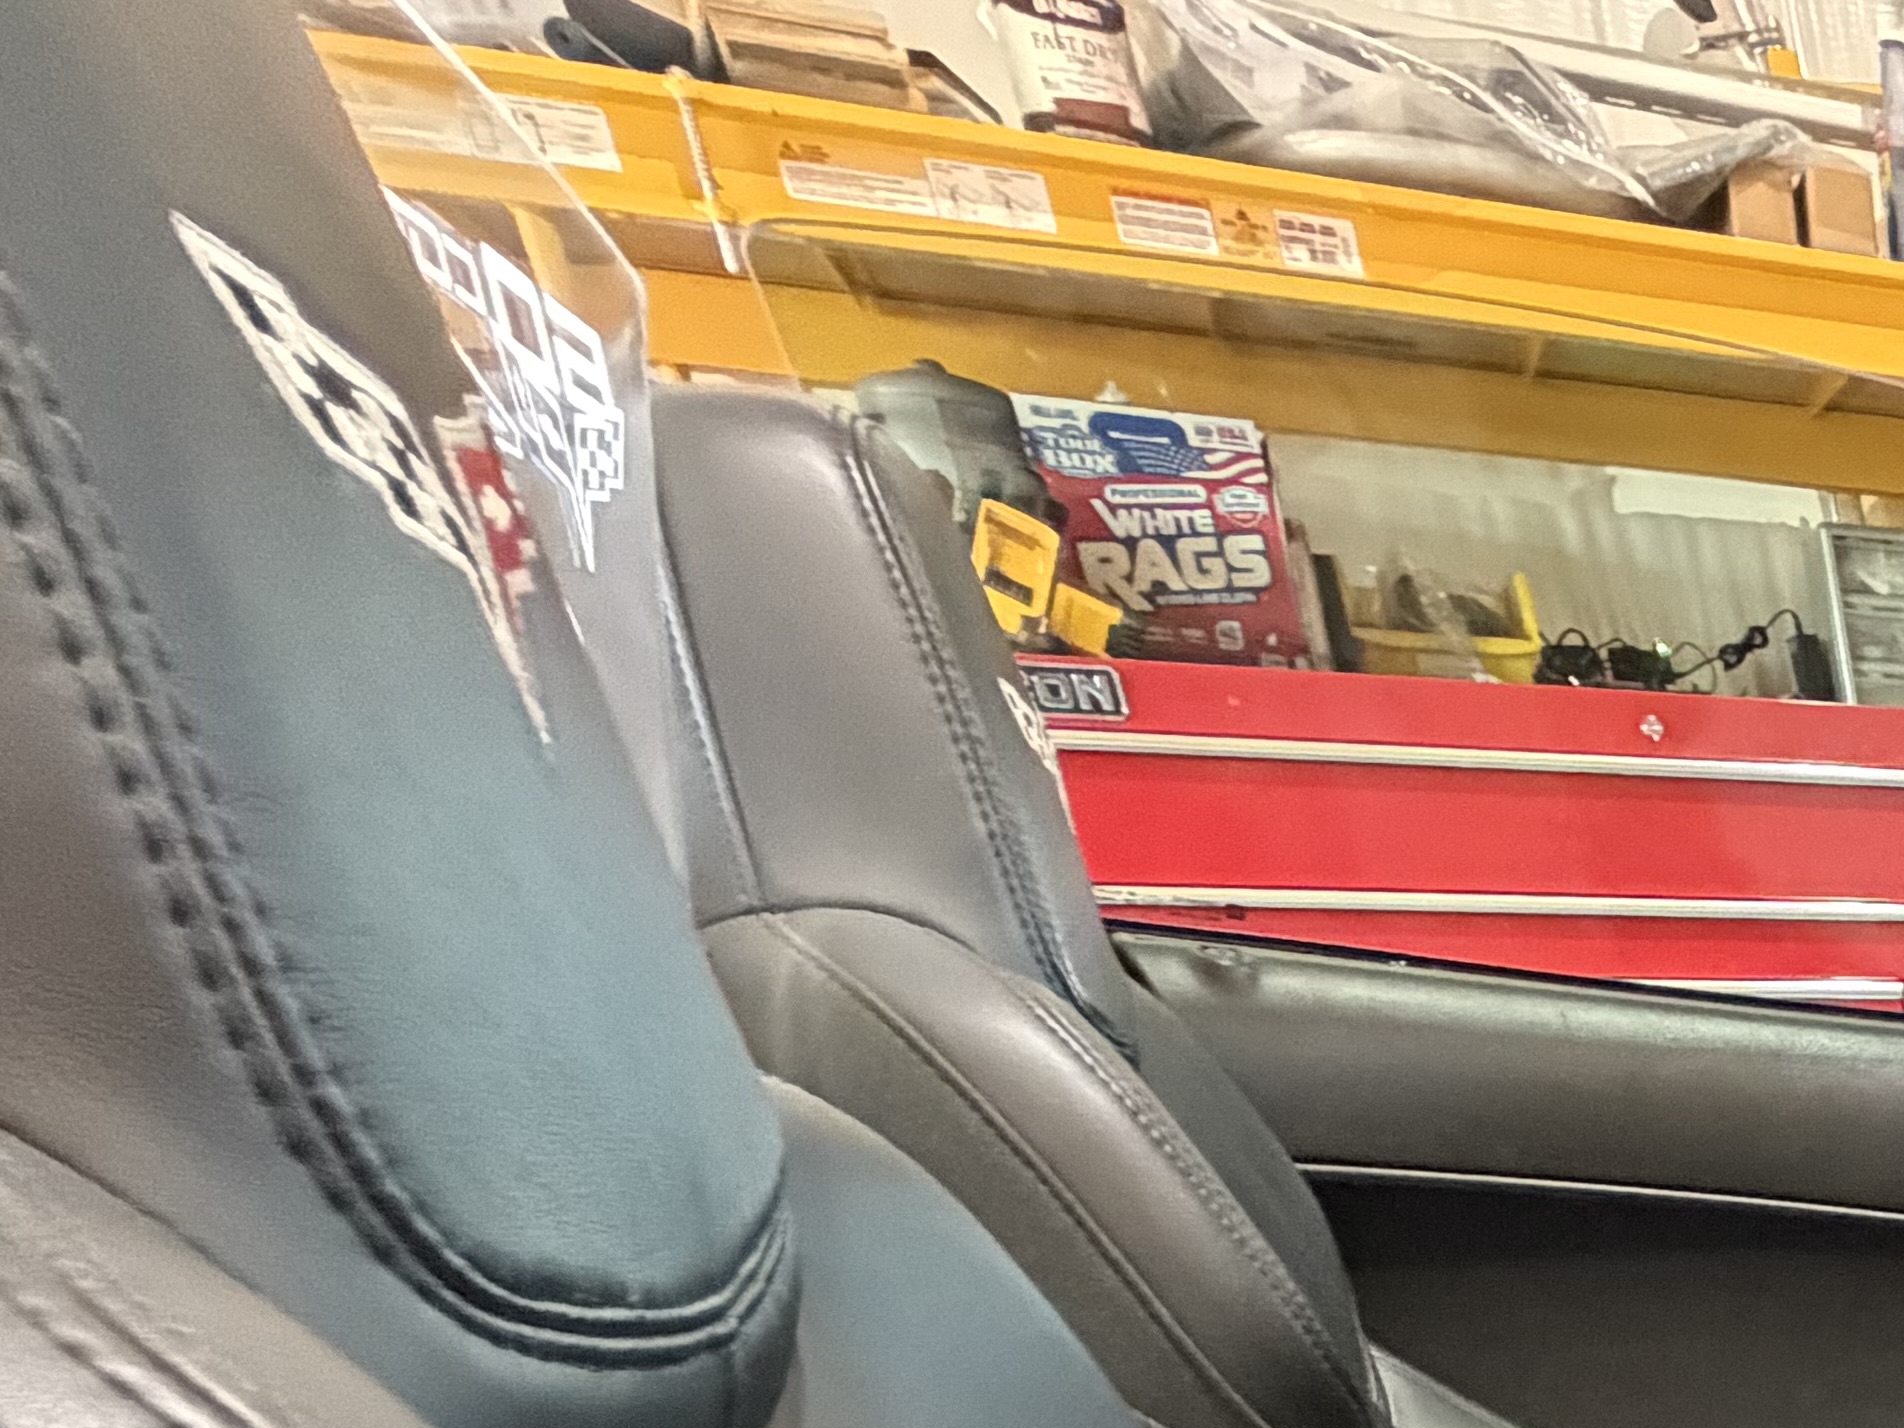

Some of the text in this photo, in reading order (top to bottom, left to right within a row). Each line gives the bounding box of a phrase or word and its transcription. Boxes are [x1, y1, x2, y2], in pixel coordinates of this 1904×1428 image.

[1043, 448, 1119, 474] BOX
[1089, 499, 1216, 538] WHITE
[1076, 534, 1272, 611] RAGS
